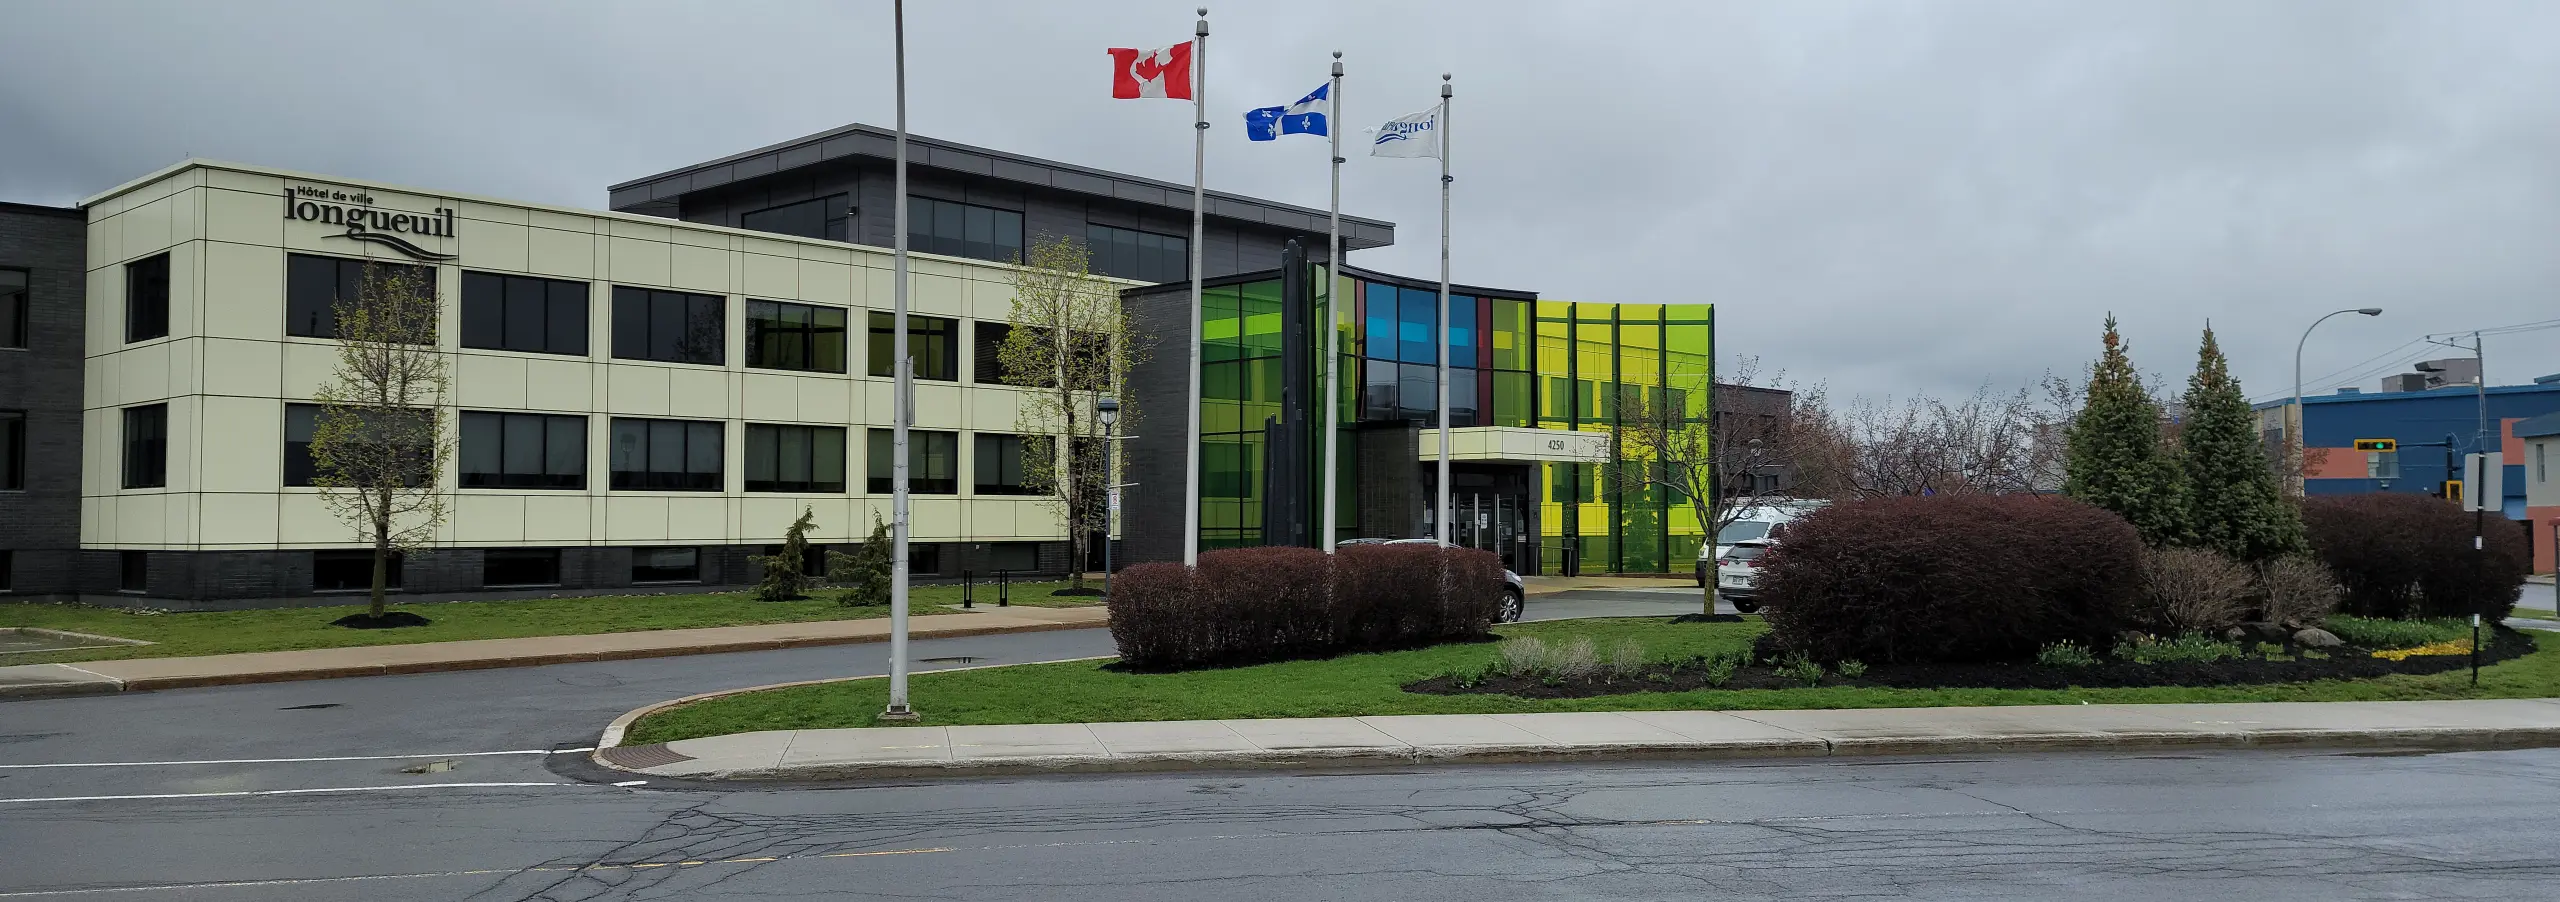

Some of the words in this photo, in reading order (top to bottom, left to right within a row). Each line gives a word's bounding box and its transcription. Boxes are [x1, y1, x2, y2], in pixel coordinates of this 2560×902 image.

[297, 185, 329, 199] Hôtel
[332, 190, 347, 201] de
[350, 193, 374, 205] ville
[284, 187, 455, 240] longueuil
[1547, 439, 1565, 451] 4250
